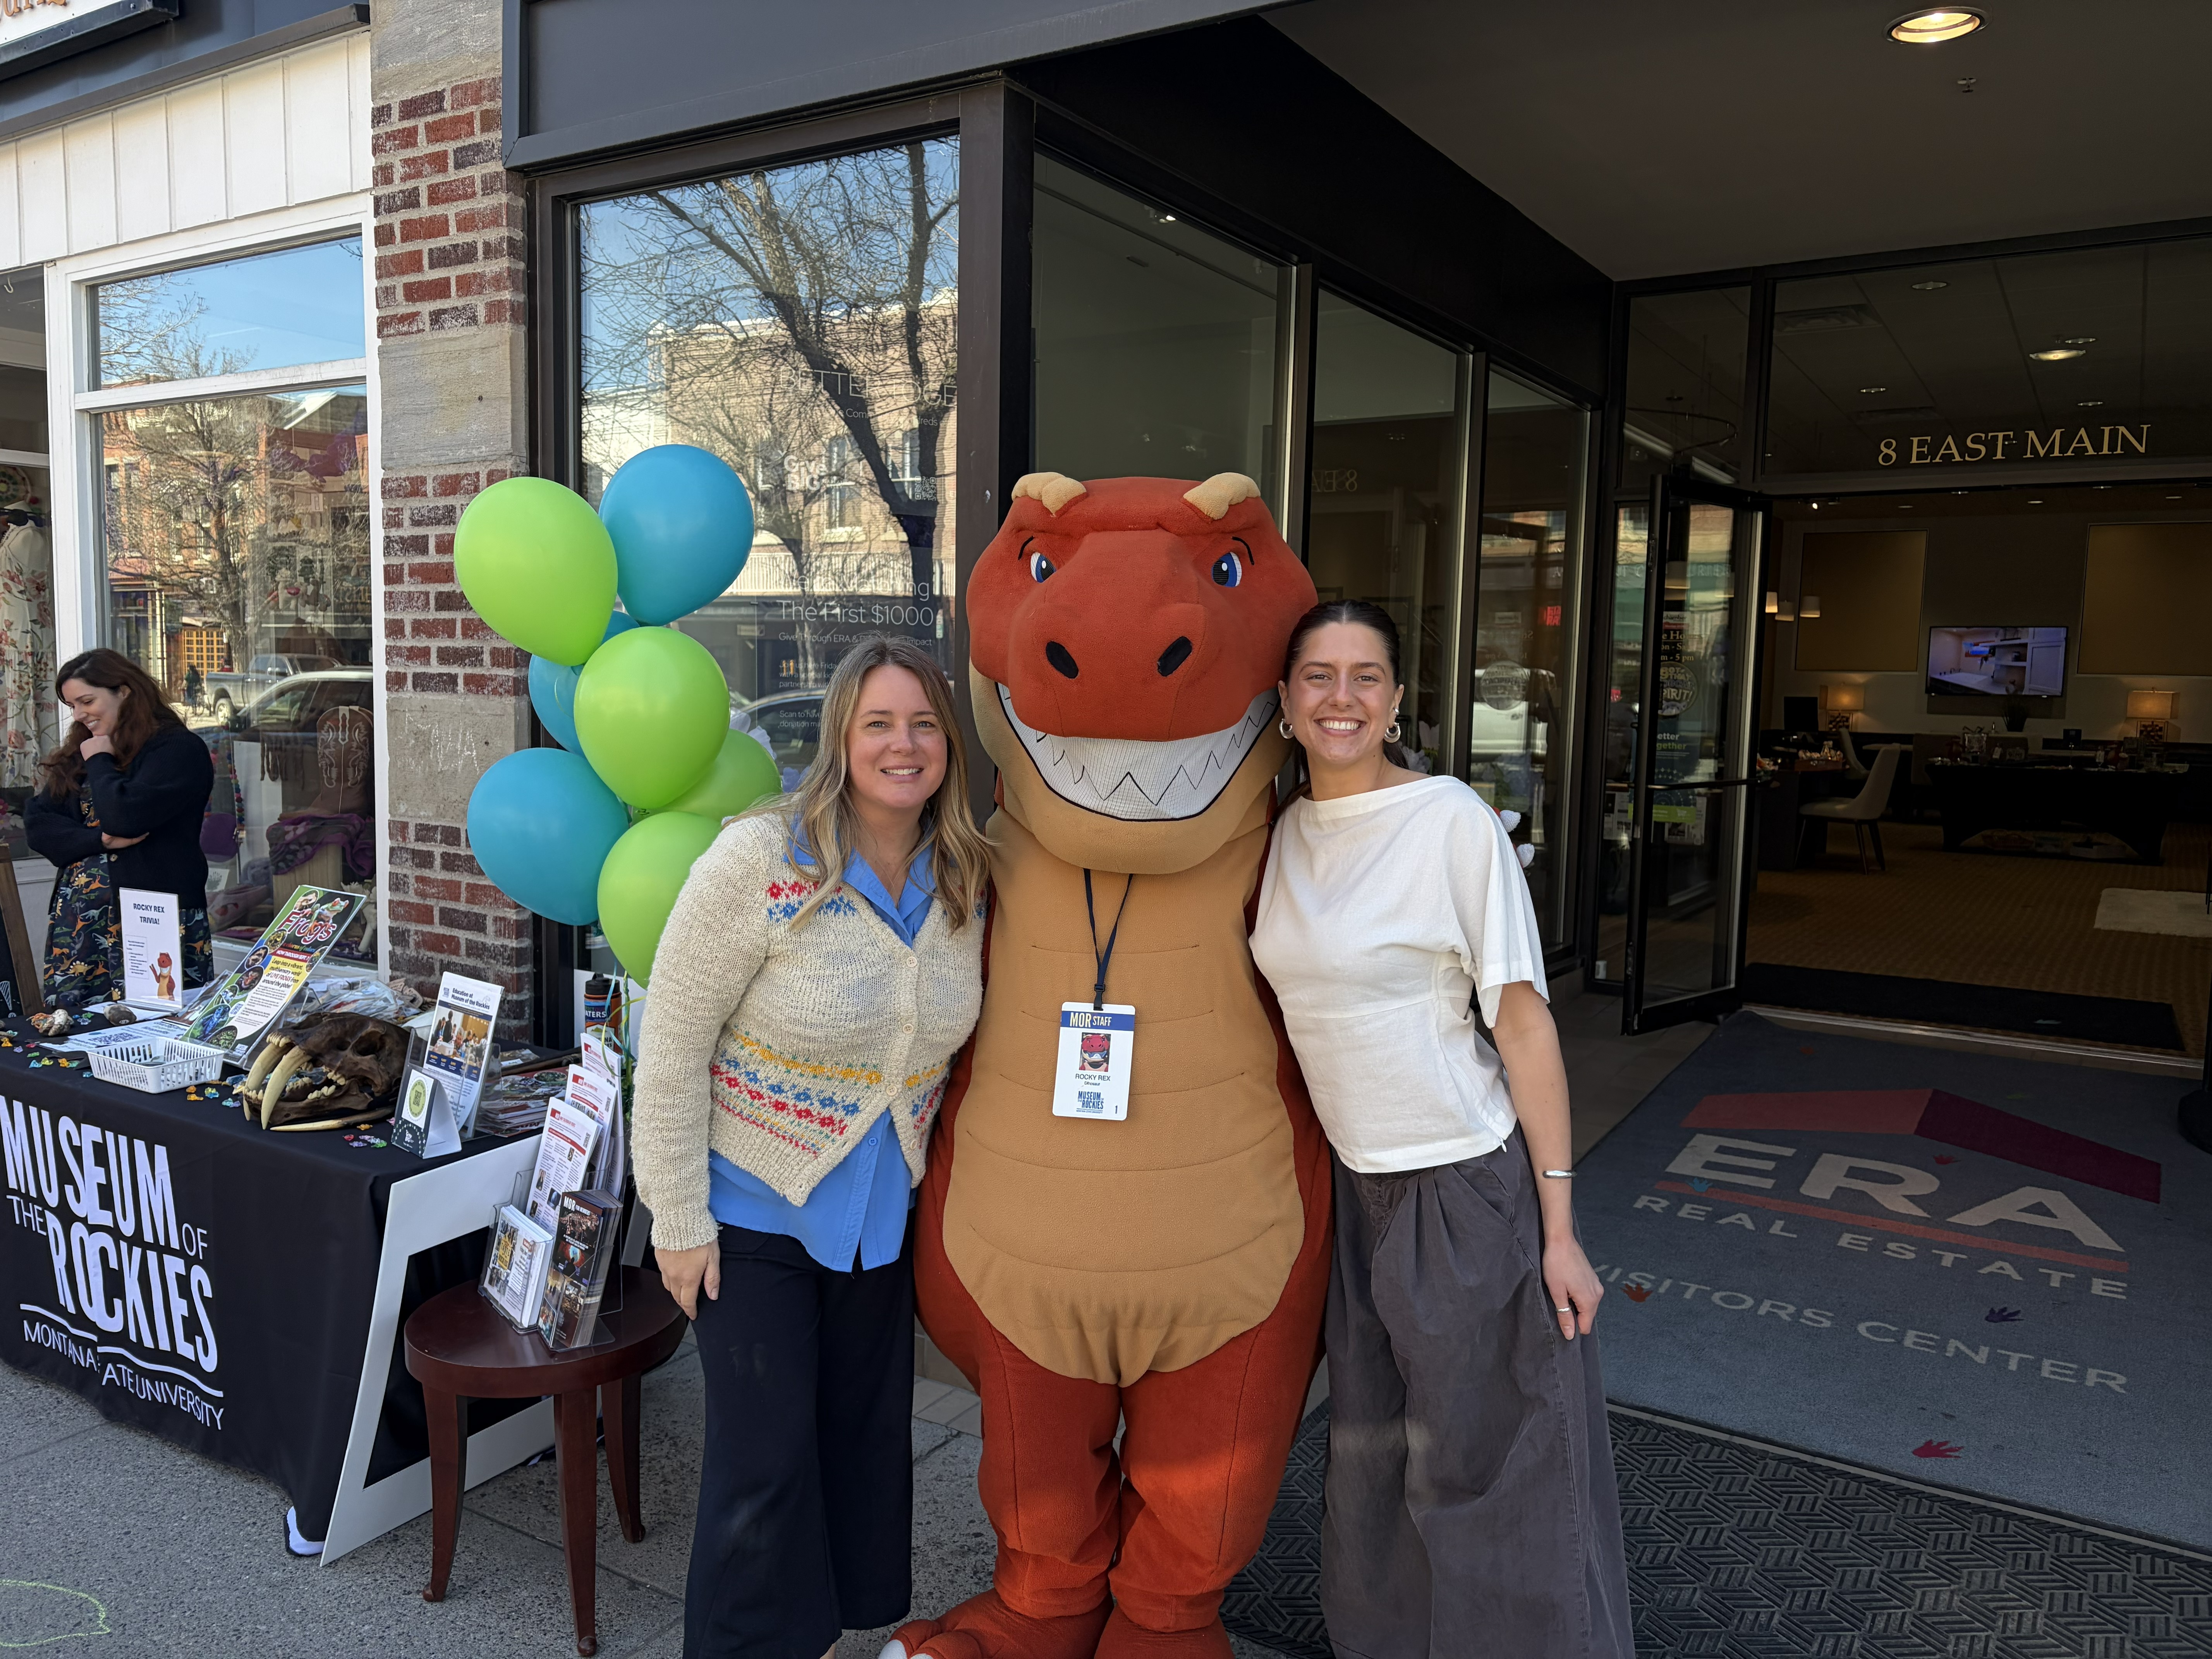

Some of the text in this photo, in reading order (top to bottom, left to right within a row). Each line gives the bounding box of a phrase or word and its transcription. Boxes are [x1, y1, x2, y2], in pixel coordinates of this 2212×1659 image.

[780, 366, 880, 398] BETTER
[1878, 424, 2151, 465] 8 EAST MAIN
[776, 600, 934, 626] The First $1000
[779, 632, 797, 641] Give
[800, 633, 832, 644] Through
[834, 634, 851, 643] ERA
[852, 635, 858, 643] &
[907, 638, 933, 646] Impact
[1663, 689, 1692, 701] PIRIT!
[1656, 742, 1687, 750] gether
[133, 903, 152, 912] ROCKY
[139, 916, 160, 925] TRIVIA!
[275, 910, 337, 945] Frogs
[452, 988, 469, 997] Education
[451, 994, 464, 1002] Museum
[476, 1001, 490, 1010] Rockies
[585, 1010, 606, 1018] ATERS
[1070, 1012, 1112, 1027] MOR STAFF
[1078, 1091, 1101, 1101] MUSEUM
[1082, 1100, 1104, 1109] ROCKIES
[1115, 1105, 1118, 1114] 1
[0, 1095, 208, 1260] MUSEUM OF
[1664, 1133, 2125, 1252] ERA
[563, 1196, 575, 1211] MOR
[1633, 1195, 2127, 1300] REAL ESTATE
[6, 1195, 218, 1373] THE ROCKIES
[1856, 1321, 2128, 1394] CENTER
[23, 1320, 224, 1430] MONTANA ATE UNIVERSITY
